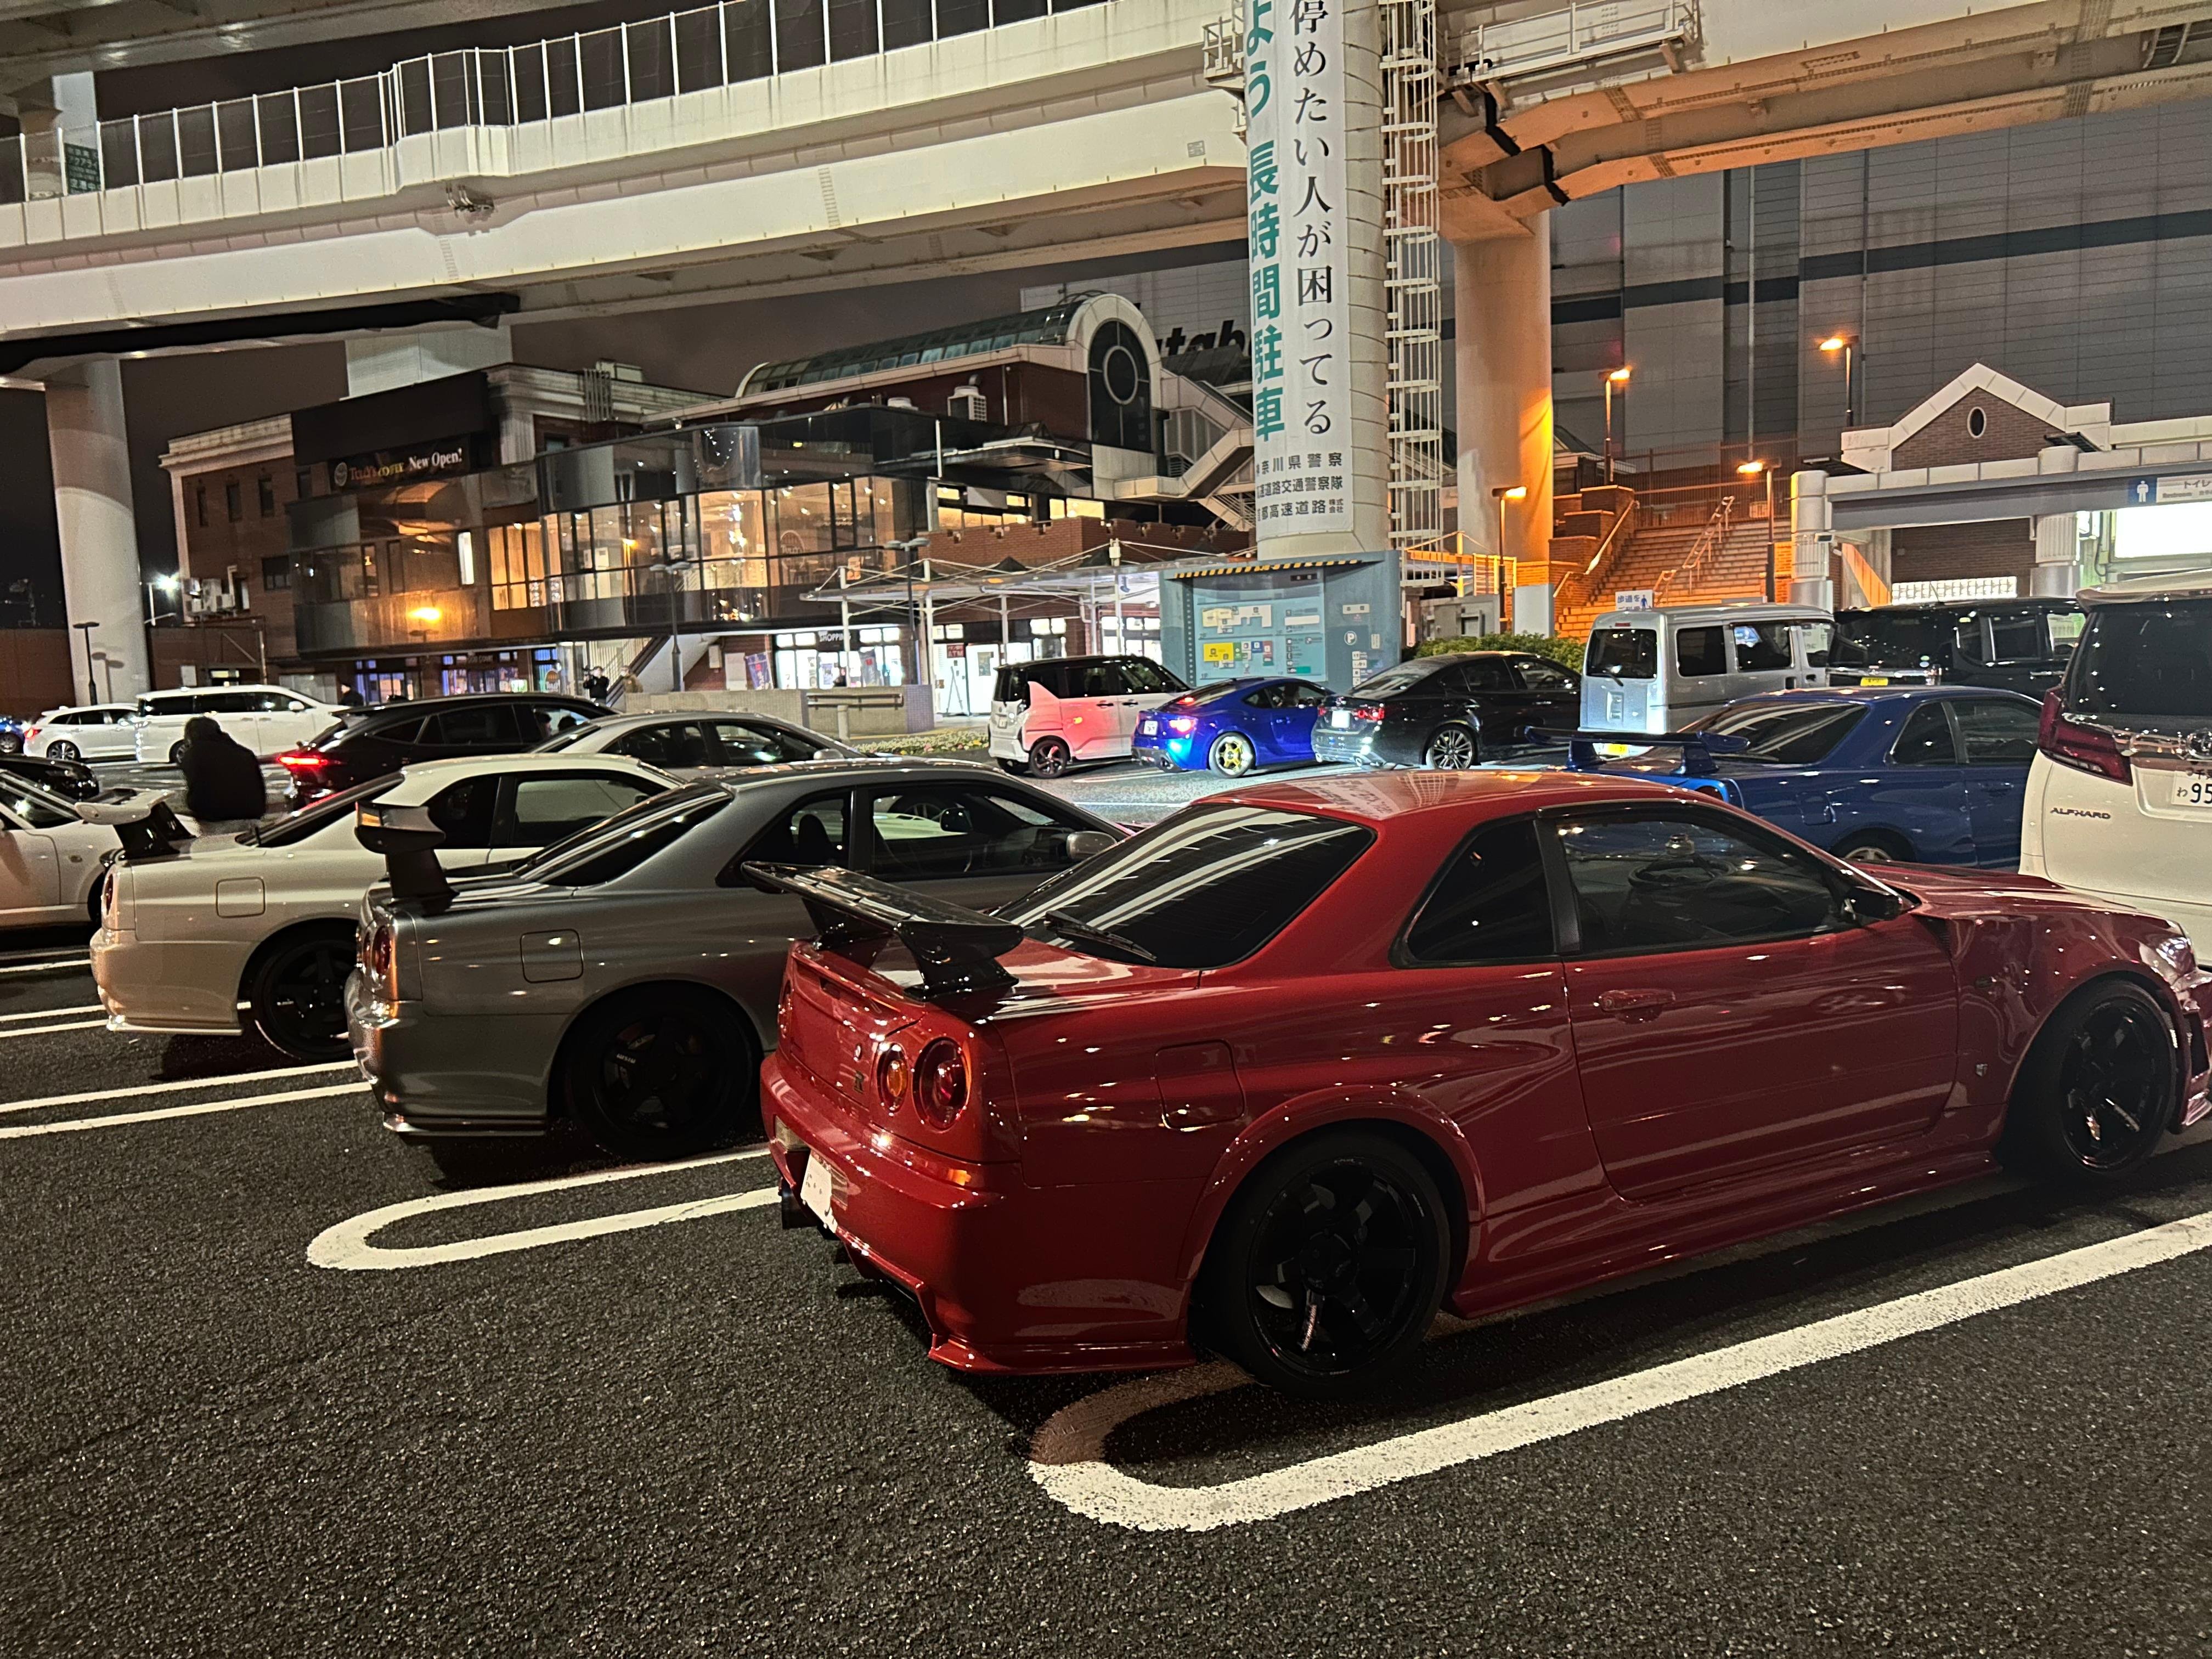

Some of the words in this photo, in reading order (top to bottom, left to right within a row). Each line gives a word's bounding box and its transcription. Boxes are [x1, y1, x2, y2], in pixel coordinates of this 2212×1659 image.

[1289, 0, 1334, 435] 停めたい人が困ってる
[1250, 140, 1285, 442] 長時間駐車
[408, 456, 430, 471] New
[432, 448, 462, 468] Open!
[1347, 633, 1355, 644] P
[2176, 787, 2188, 797] わ
[2051, 808, 2111, 819] ALPHARD
